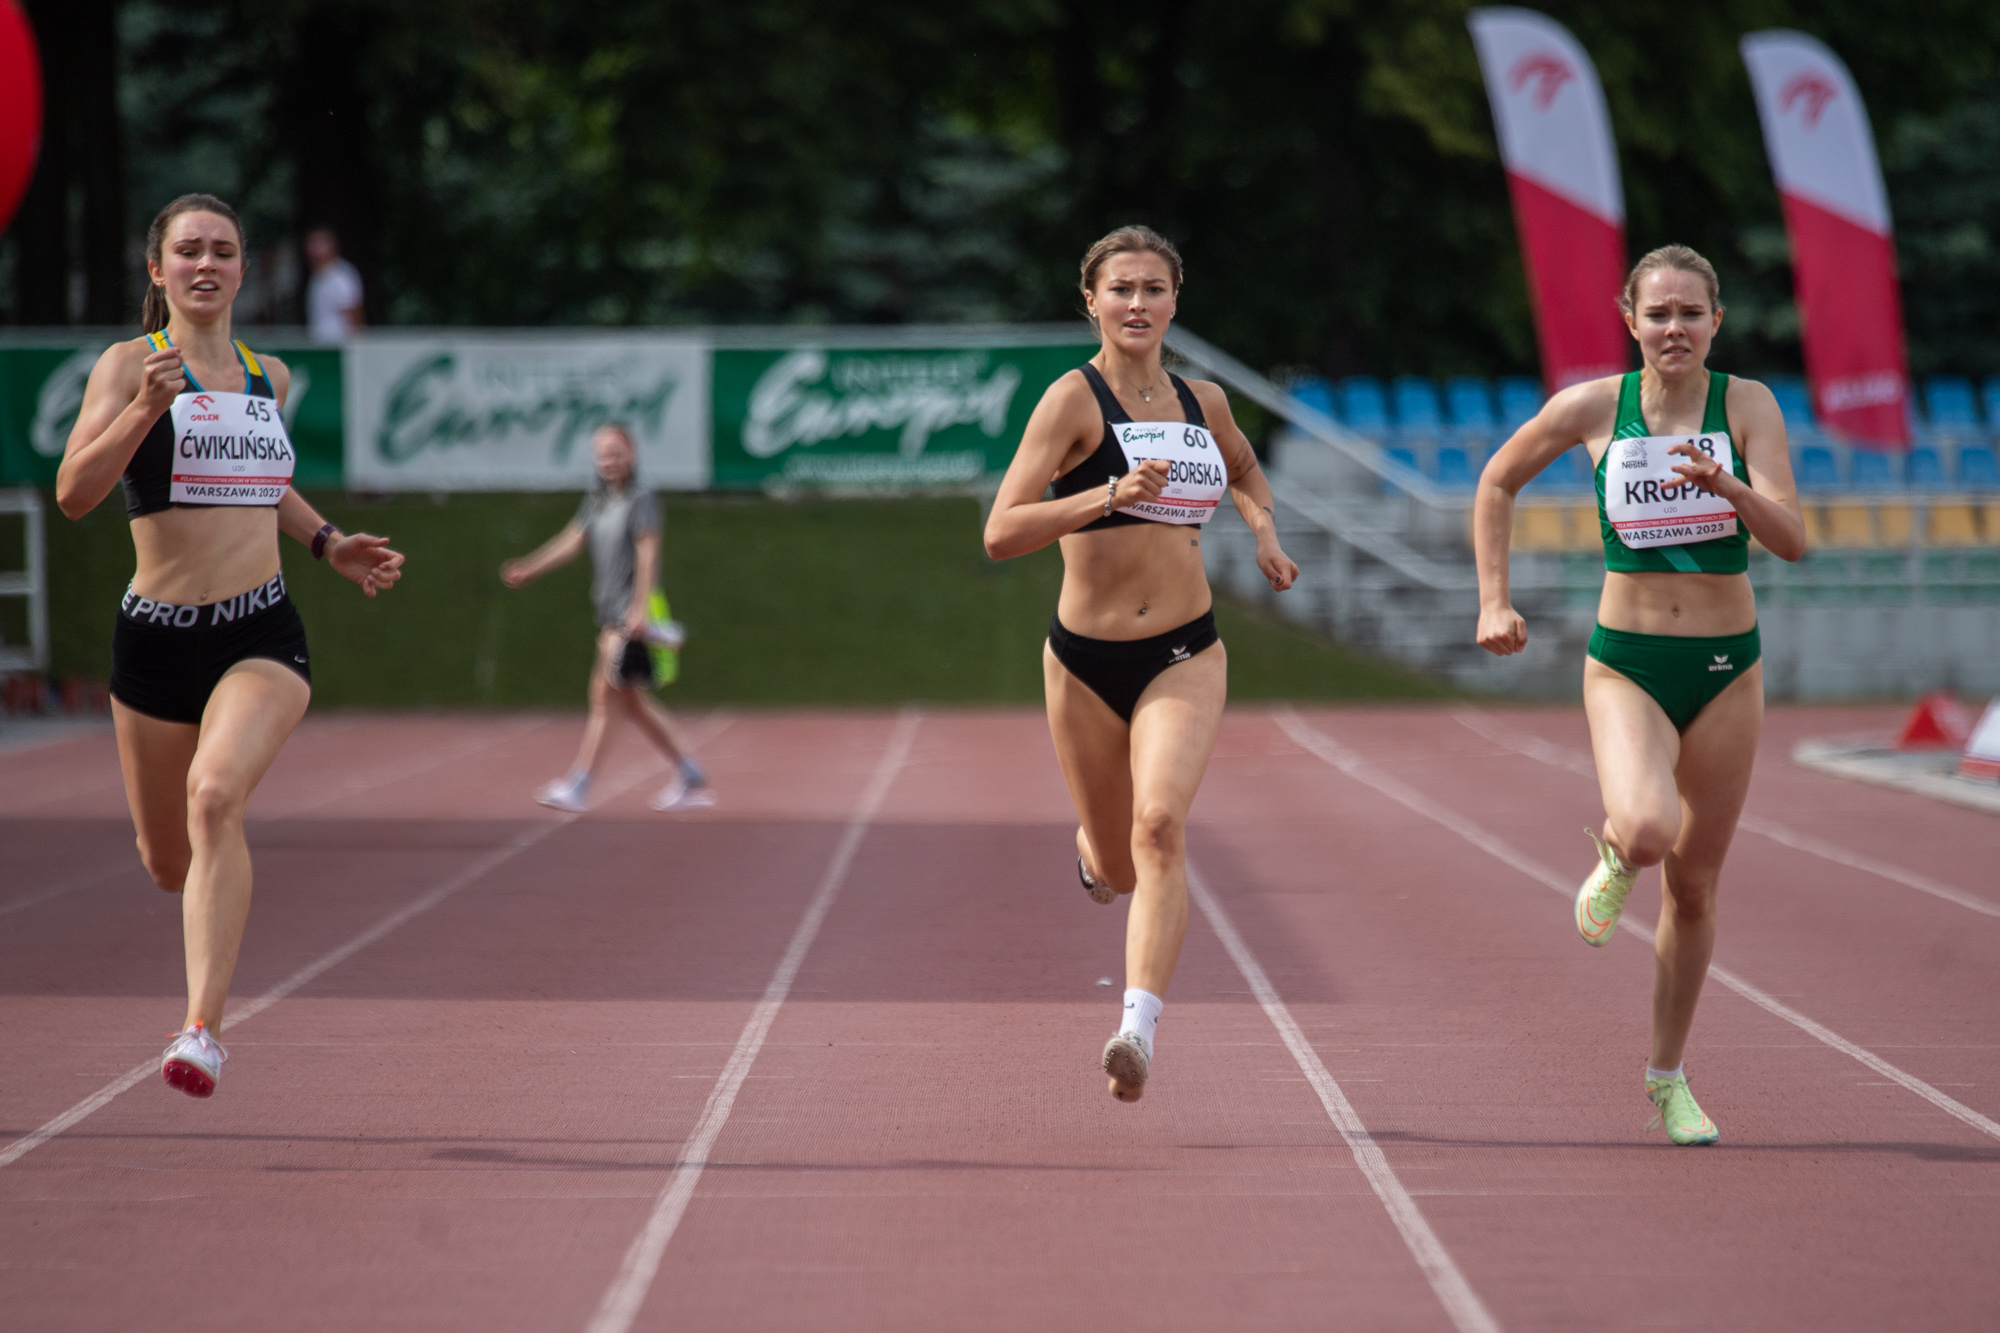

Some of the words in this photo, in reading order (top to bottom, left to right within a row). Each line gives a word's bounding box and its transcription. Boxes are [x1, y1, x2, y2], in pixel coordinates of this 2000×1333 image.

[190, 414, 219, 422] ORLEN
[245, 399, 271, 422] 45
[179, 429, 292, 461] ĆWIKLIŃSKA
[1183, 427, 1208, 449] 60
[186, 486, 257, 498] WARSZAWA
[259, 488, 281, 498] 2023
[1128, 503, 1185, 518] WARSZAWA
[1187, 509, 1207, 518] 2023
[1622, 526, 1693, 541] WARSZAWA
[1696, 523, 1725, 535] 2023
[130, 597, 199, 628] PRO
[211, 577, 283, 626] NIKE
[1708, 663, 1733, 672] erima
